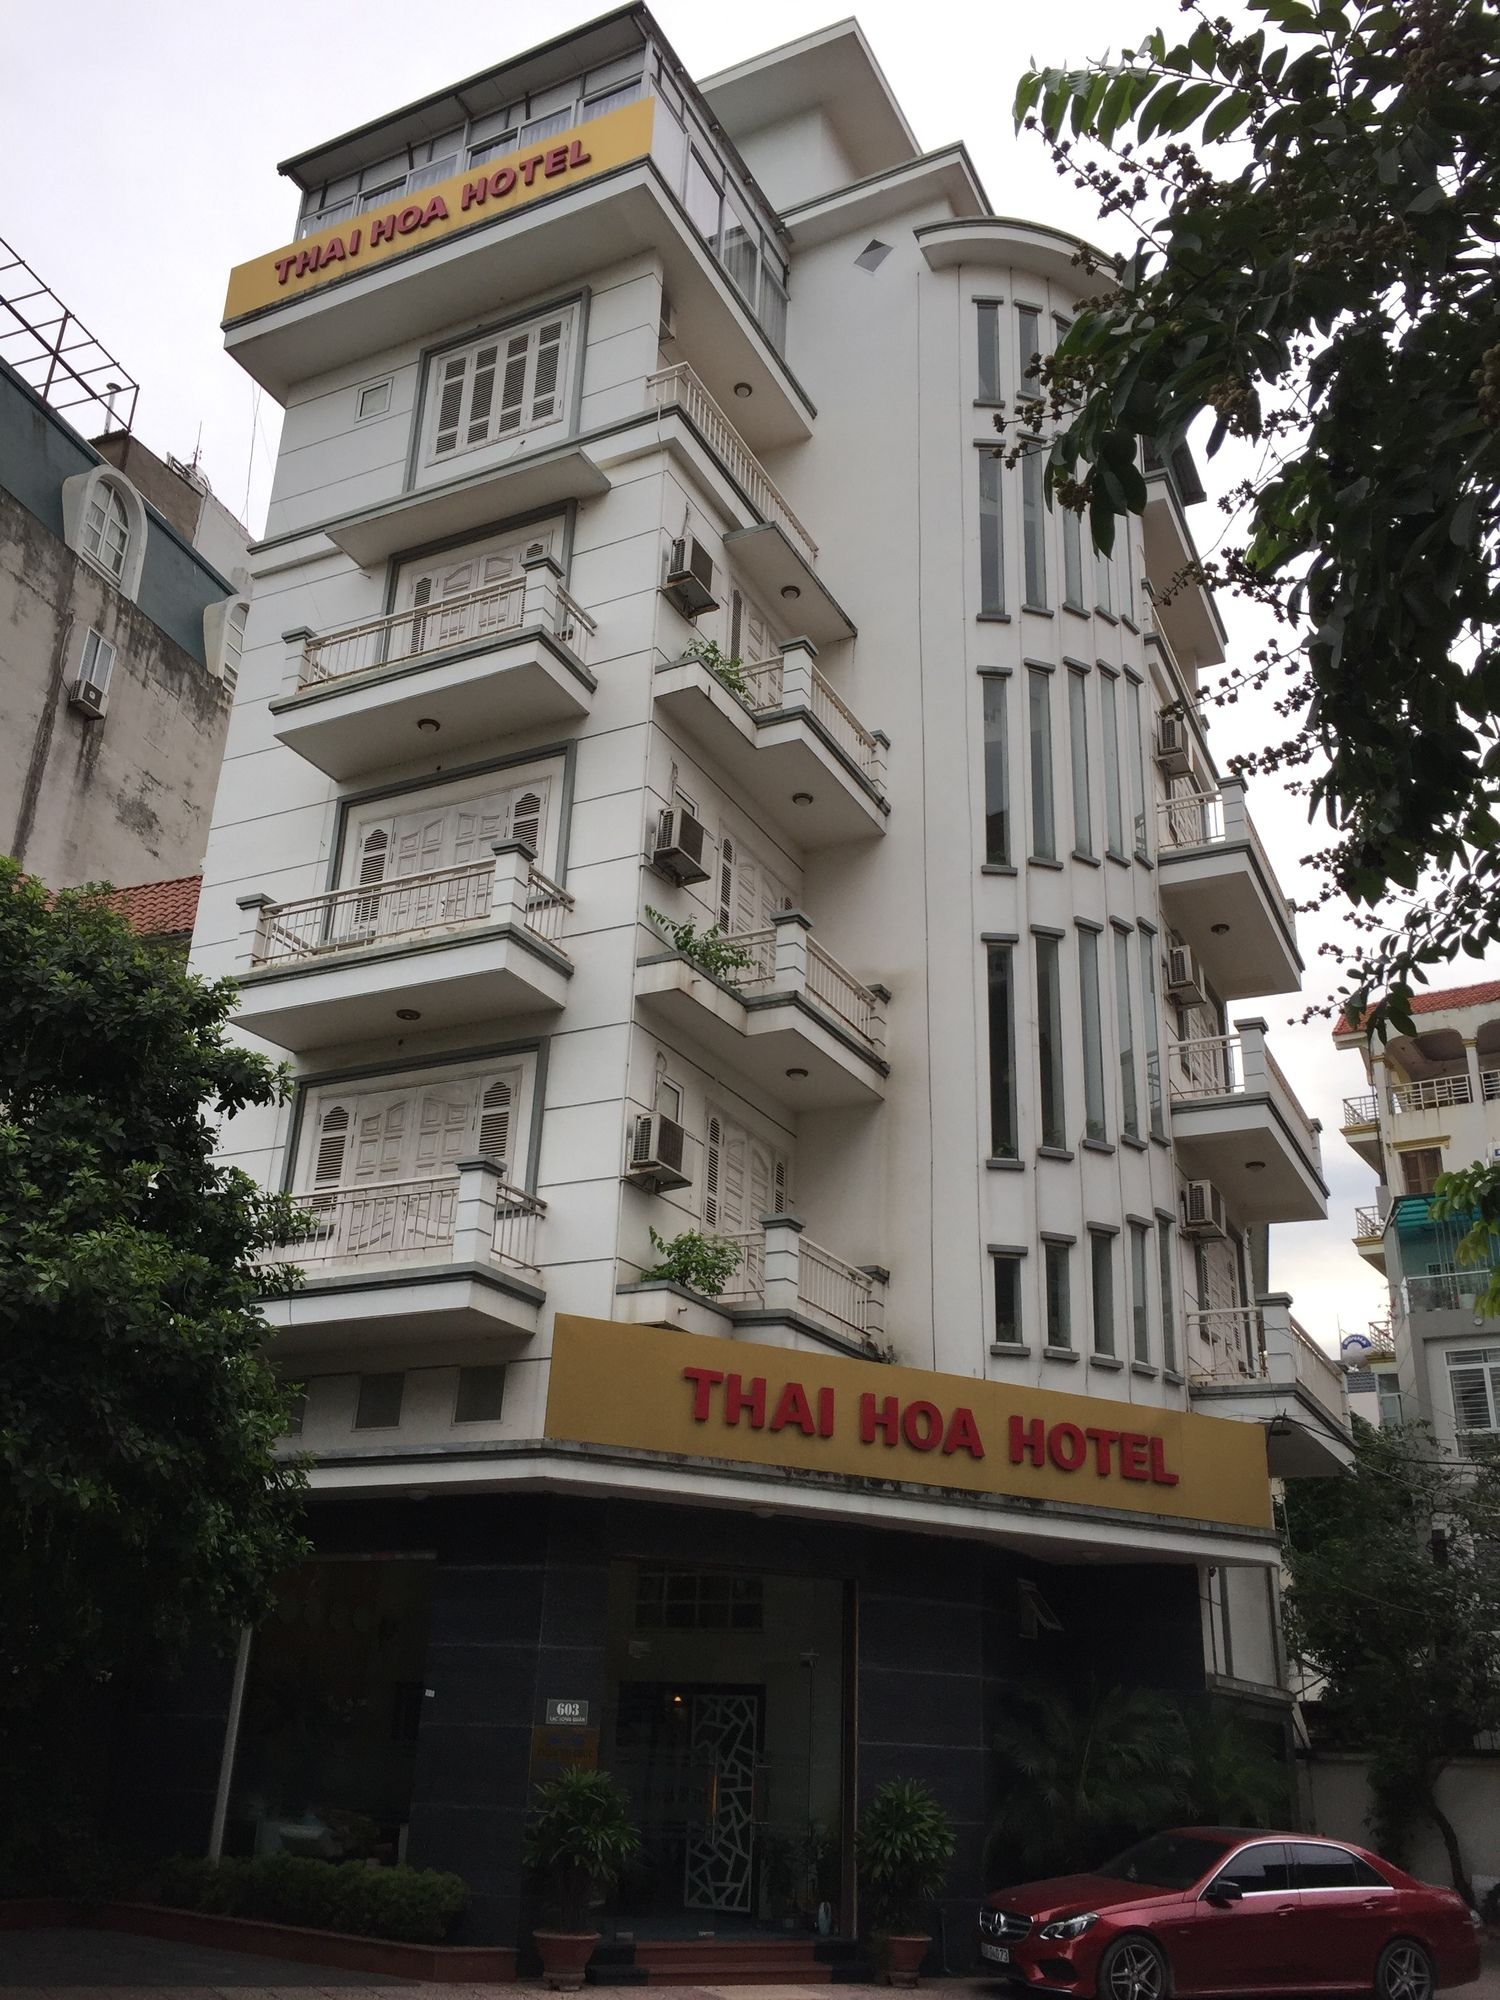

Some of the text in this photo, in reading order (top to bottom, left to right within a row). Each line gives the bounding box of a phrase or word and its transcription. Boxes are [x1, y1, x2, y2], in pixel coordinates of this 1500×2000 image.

[275, 140, 591, 284] THAI HOA HOTEL
[684, 1366, 1180, 1485] THAI HOA HOTEL
[556, 1703, 580, 1716] 603
